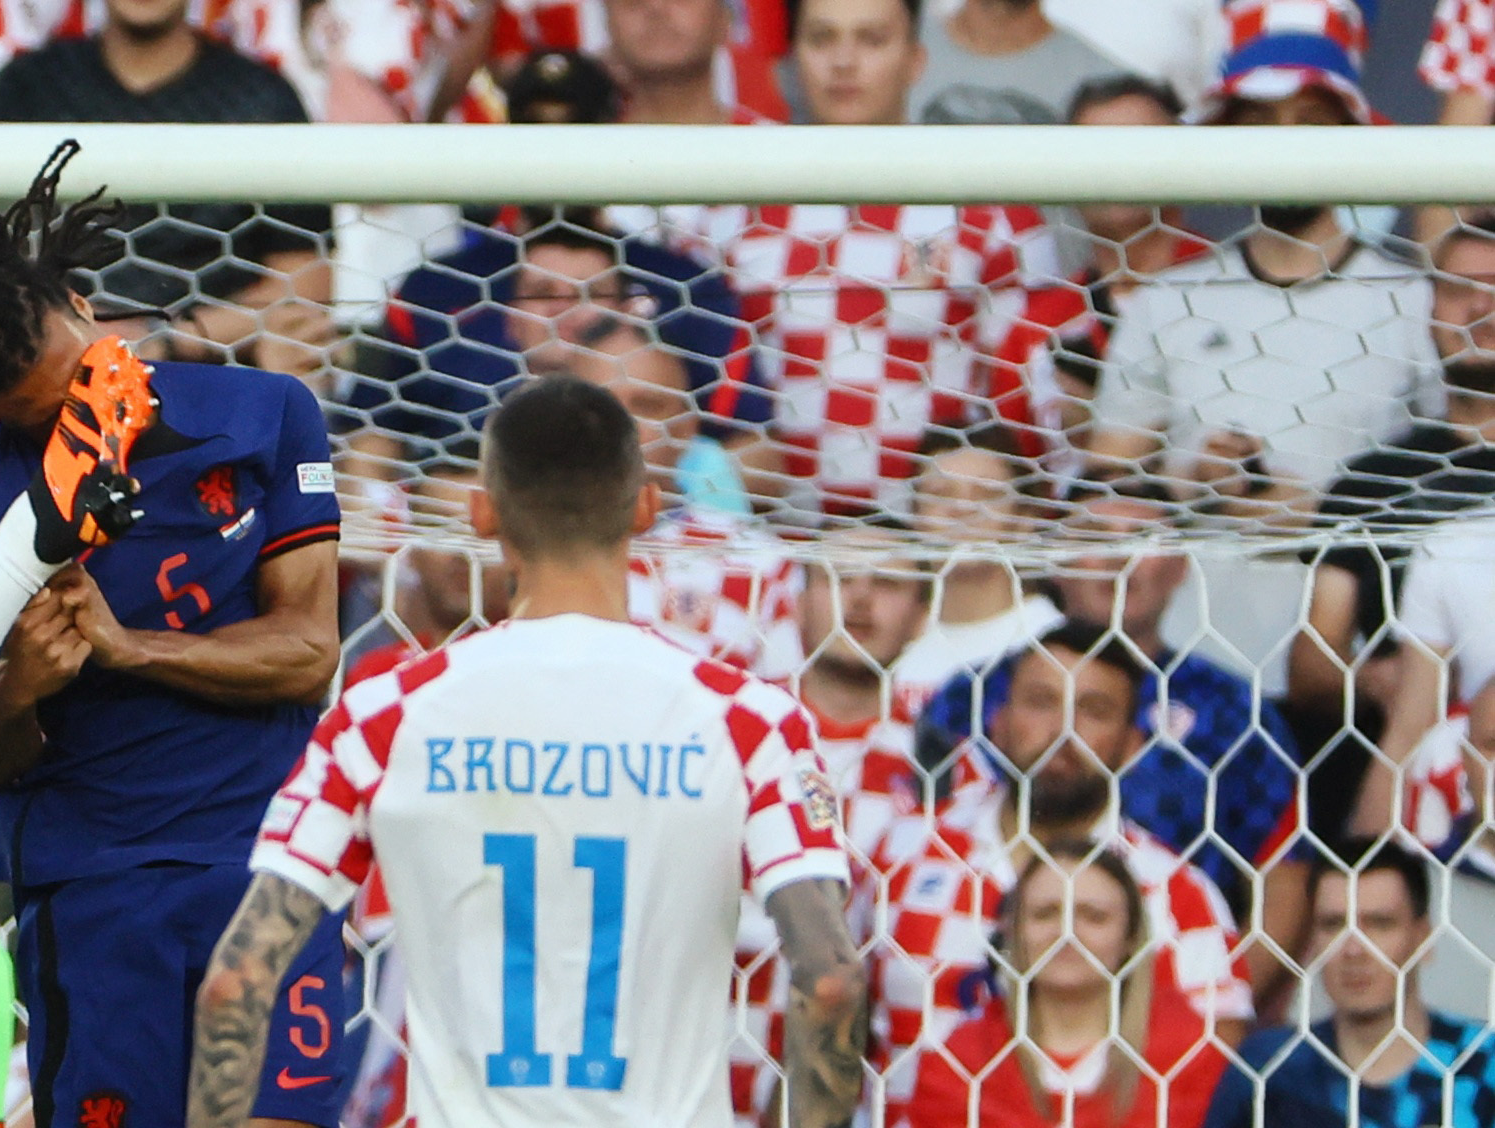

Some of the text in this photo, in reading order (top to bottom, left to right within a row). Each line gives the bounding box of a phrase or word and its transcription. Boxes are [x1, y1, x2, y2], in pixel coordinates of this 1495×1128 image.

[155, 551, 212, 629] 5
[425, 732, 707, 798] BROZOVIĆ
[482, 833, 629, 1091] 11
[288, 974, 331, 1058] 5
